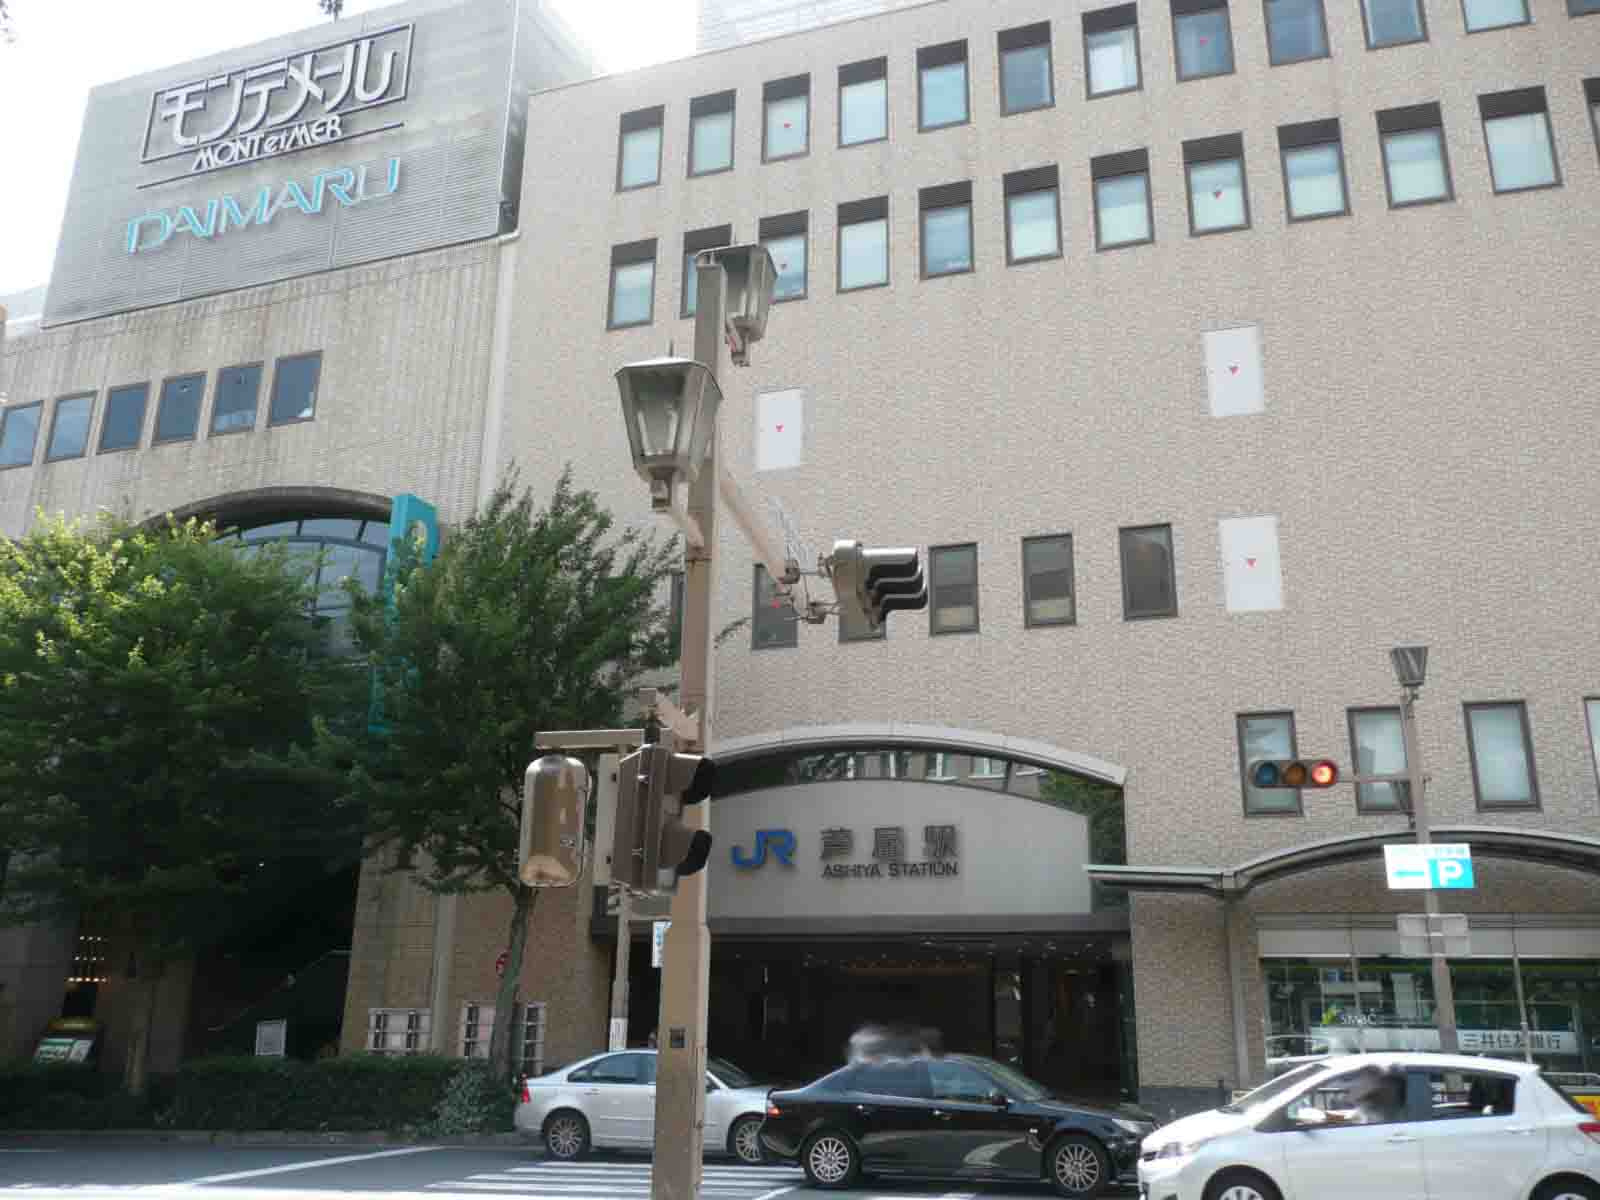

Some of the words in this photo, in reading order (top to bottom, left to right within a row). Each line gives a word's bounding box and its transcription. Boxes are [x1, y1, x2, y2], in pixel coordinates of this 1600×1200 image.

[160, 39, 400, 146] モンテメール
[126, 157, 402, 256] DAIMARU
[730, 828, 798, 870] JR
[820, 825, 958, 860] 芦屋駅
[821, 863, 881, 879] ASHIYA
[887, 861, 960, 879] STATION
[1438, 860, 1465, 886] P
